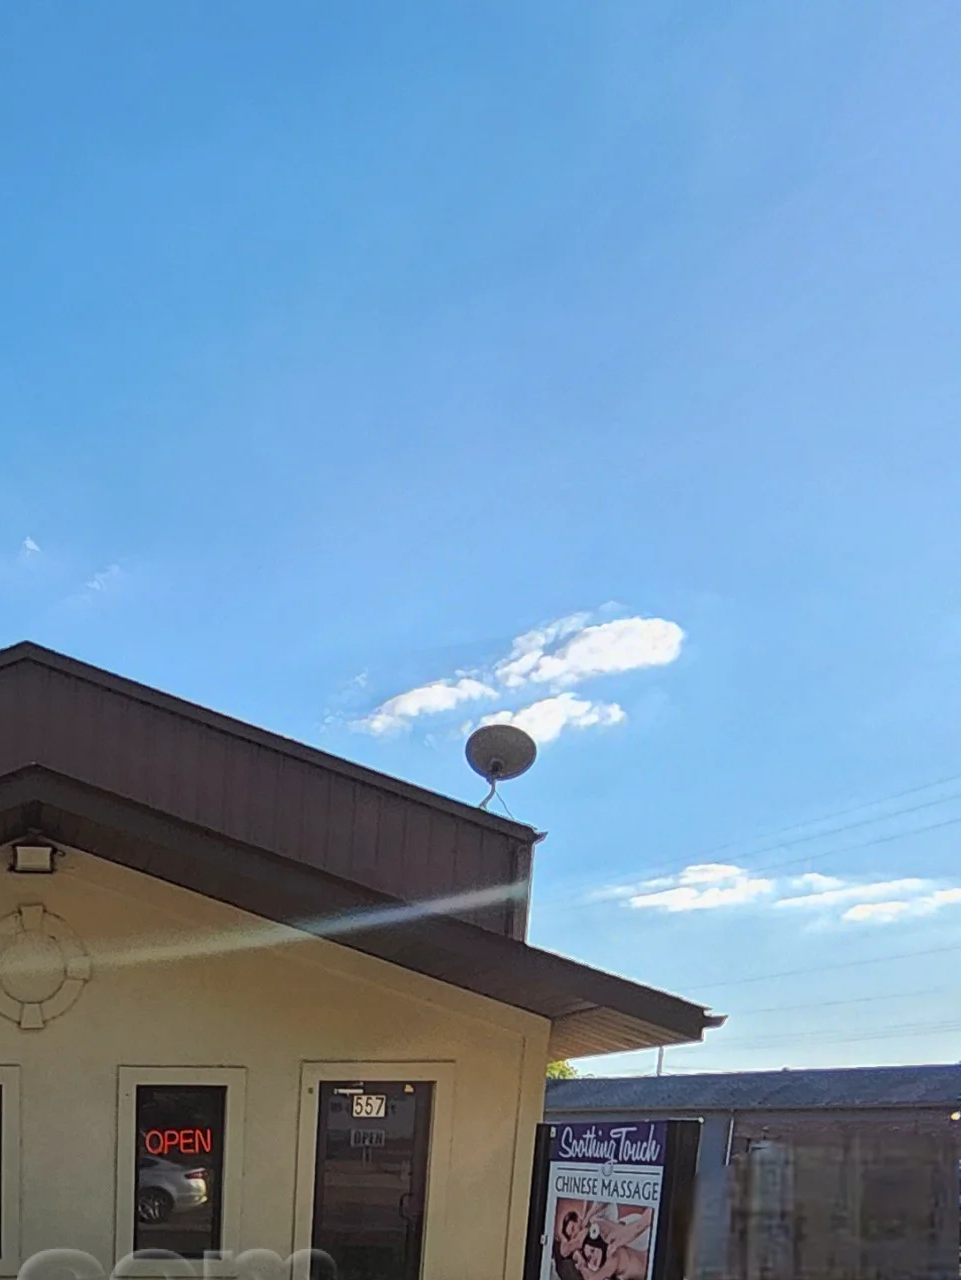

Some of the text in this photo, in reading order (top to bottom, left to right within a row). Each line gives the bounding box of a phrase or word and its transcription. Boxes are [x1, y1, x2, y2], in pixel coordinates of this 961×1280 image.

[355, 1097, 384, 1115] 557
[145, 1129, 212, 1154] OPEN
[354, 1131, 383, 1145] OPEN
[559, 1124, 660, 1164] Soothing Touch
[555, 1175, 659, 1201] CHINESE MASSAGE
